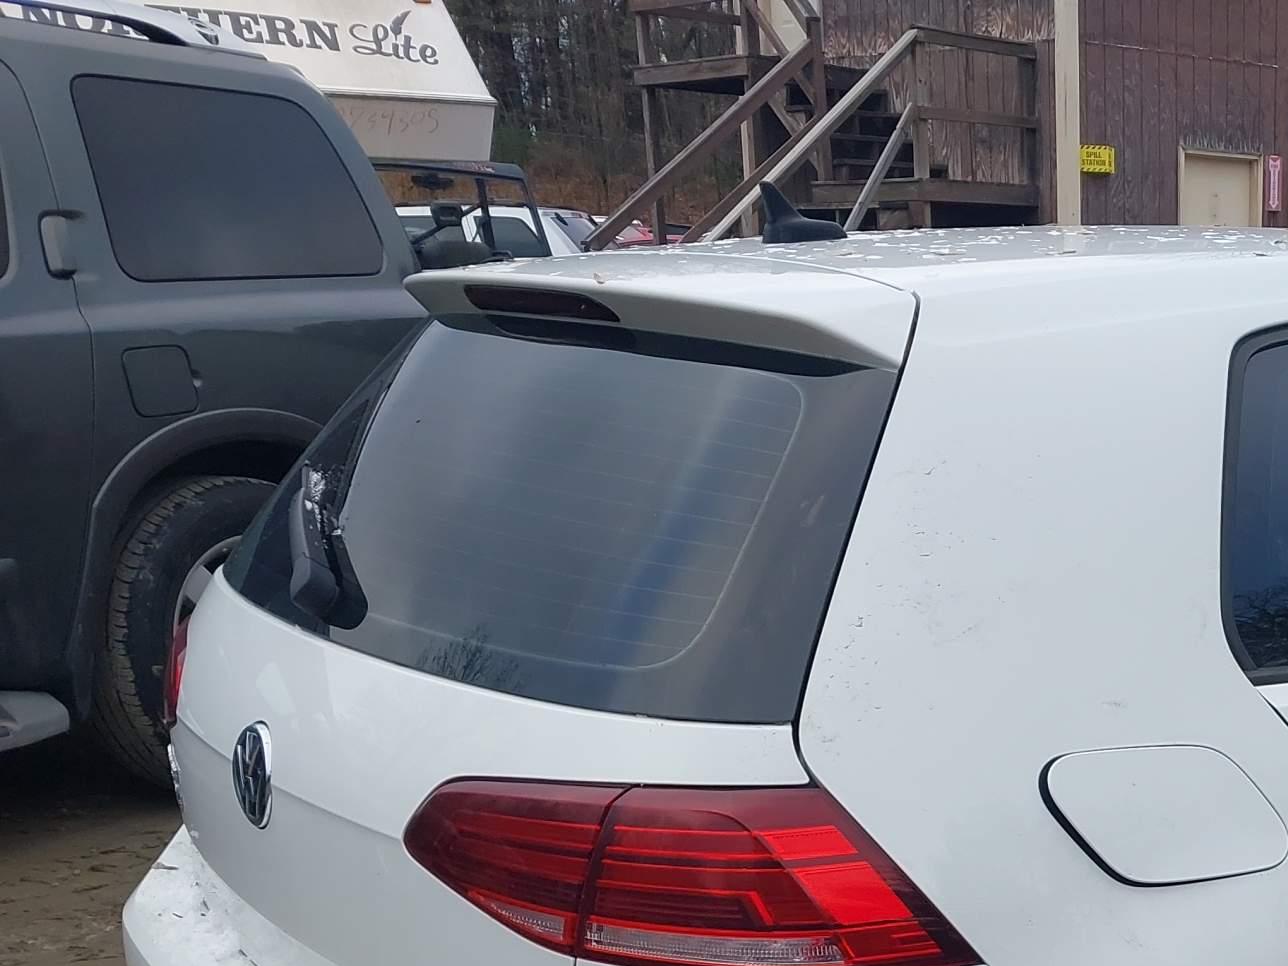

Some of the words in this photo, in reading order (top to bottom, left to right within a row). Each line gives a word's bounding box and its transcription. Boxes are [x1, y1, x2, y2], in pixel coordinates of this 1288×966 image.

[349, 10, 439, 65] Lite
[1085, 151, 1103, 159] SPILL
[1081, 159, 1106, 167] STATION
